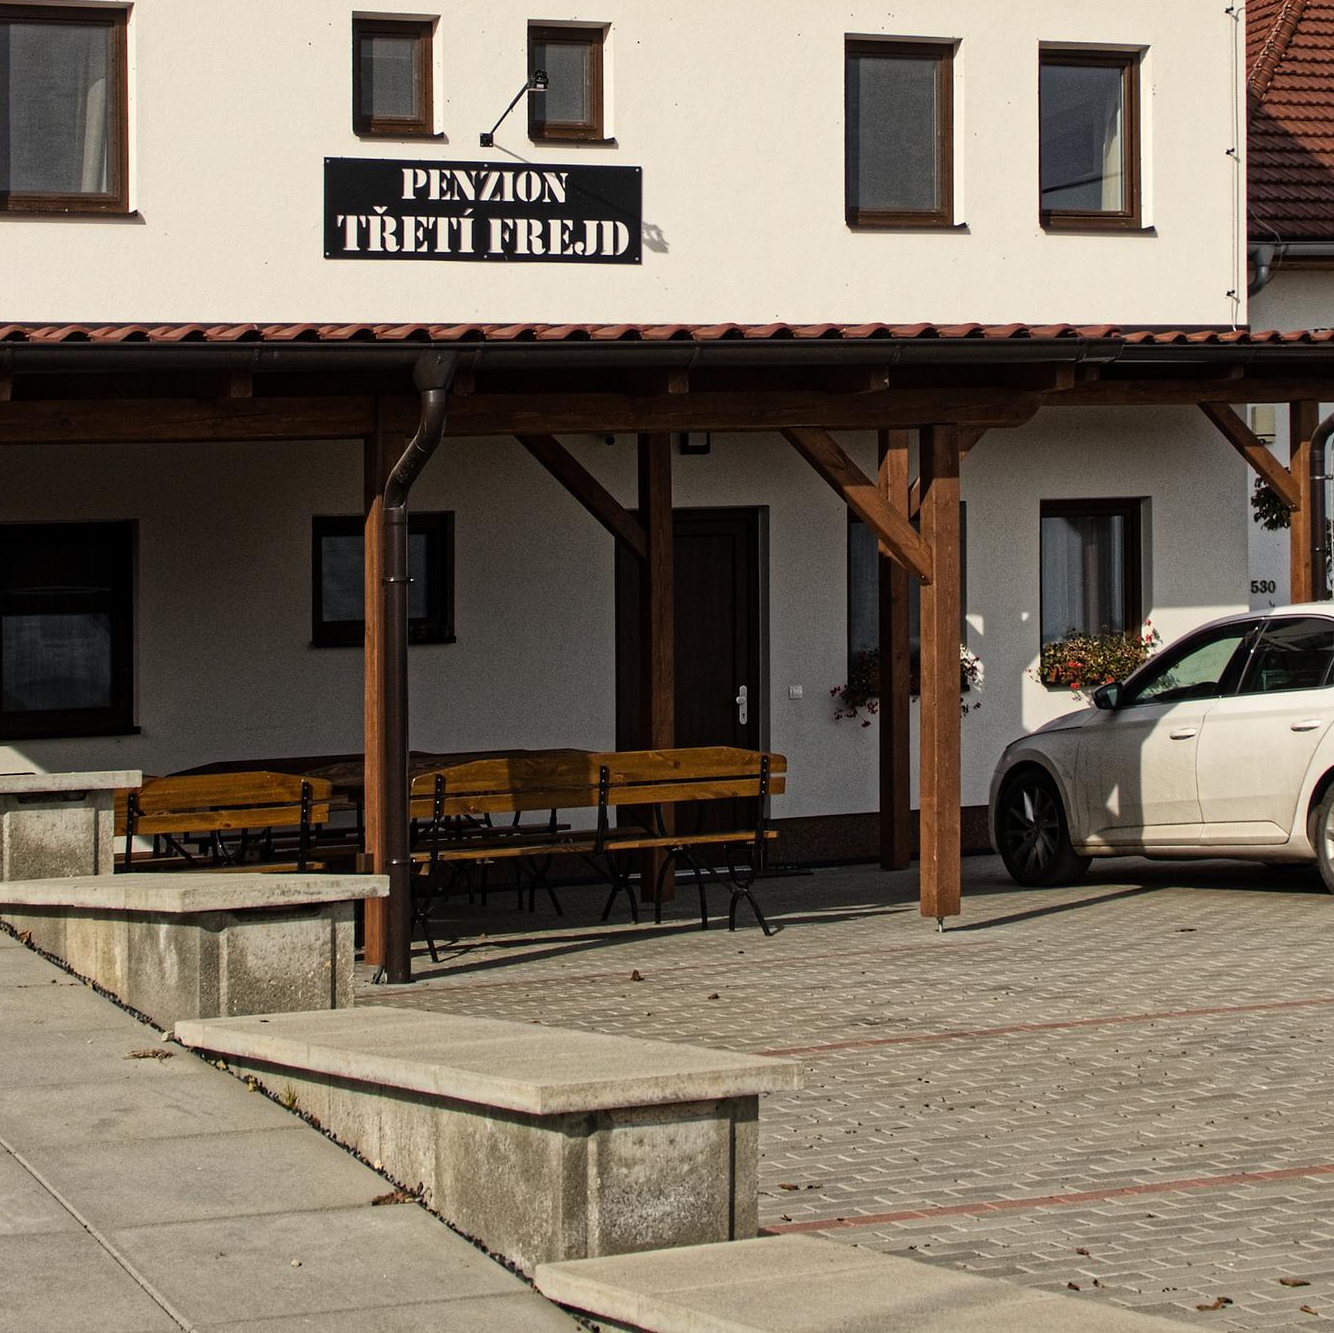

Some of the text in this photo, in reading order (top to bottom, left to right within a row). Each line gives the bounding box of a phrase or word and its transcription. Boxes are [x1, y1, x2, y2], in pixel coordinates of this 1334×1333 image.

[401, 168, 569, 204] PENZION
[337, 205, 630, 256] TŘETÍ FREJD
[1250, 579, 1276, 594] 530
